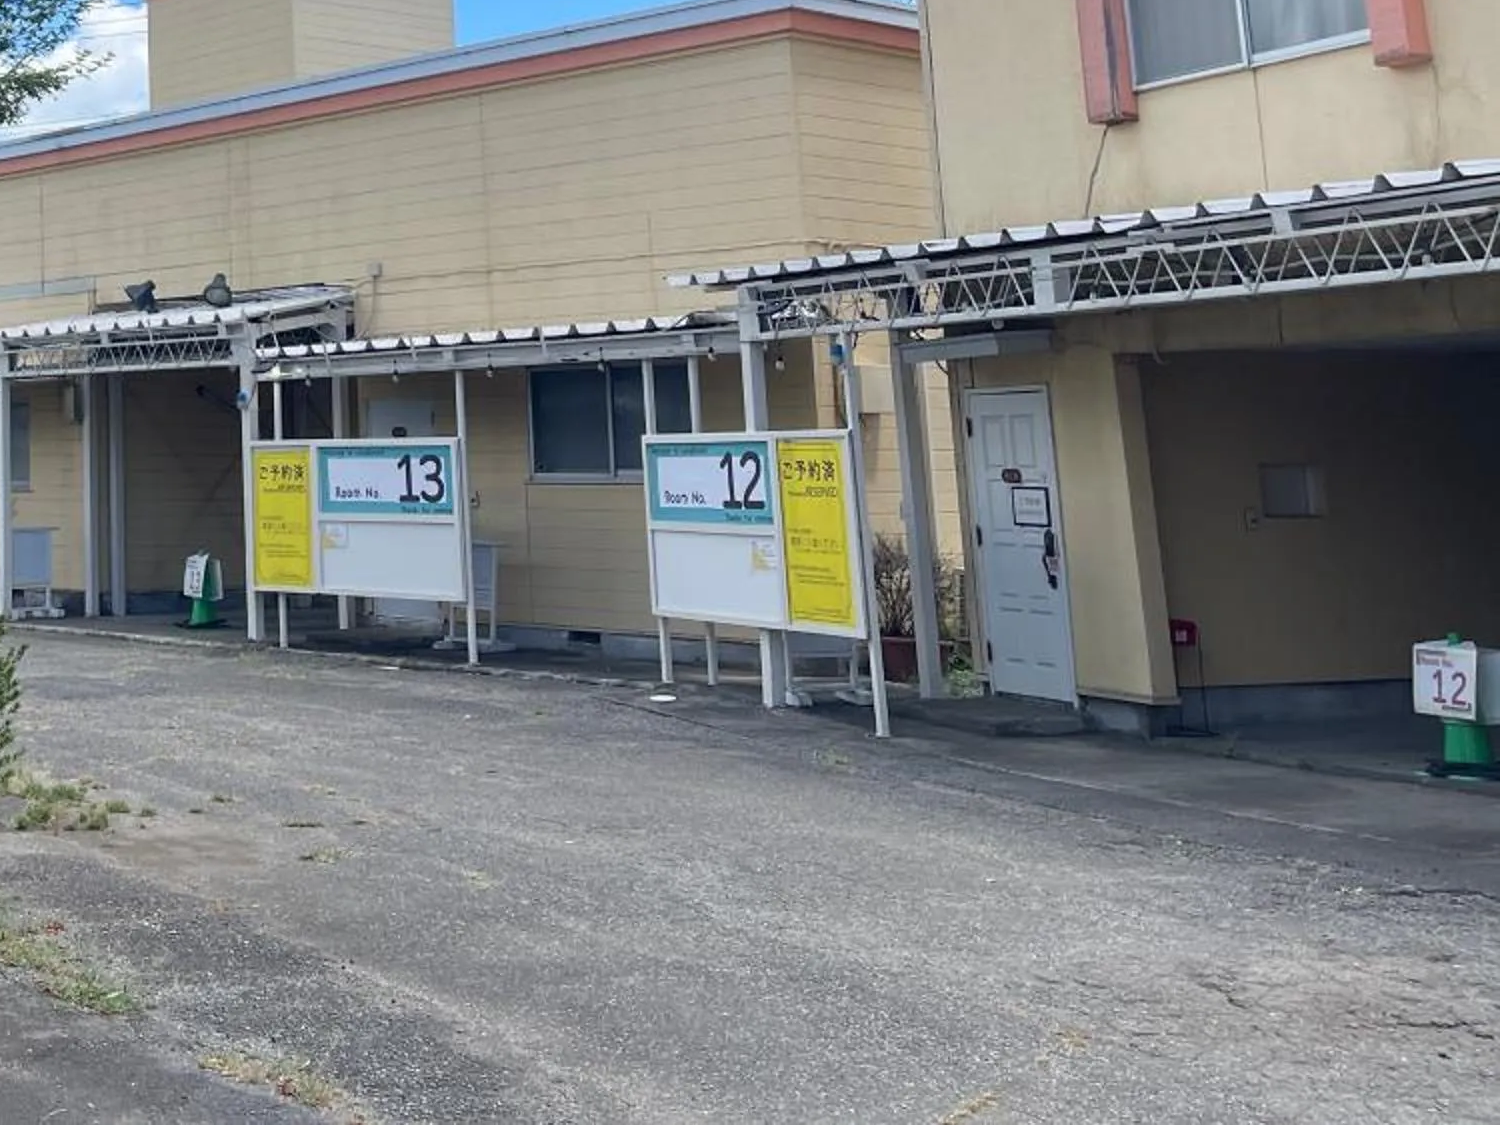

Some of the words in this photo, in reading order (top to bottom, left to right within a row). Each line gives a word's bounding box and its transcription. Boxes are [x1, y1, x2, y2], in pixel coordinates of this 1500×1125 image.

[397, 453, 445, 503] 13
[719, 451, 766, 509] 12
[782, 459, 835, 482] ご予約済
[1432, 669, 1468, 706] 12
